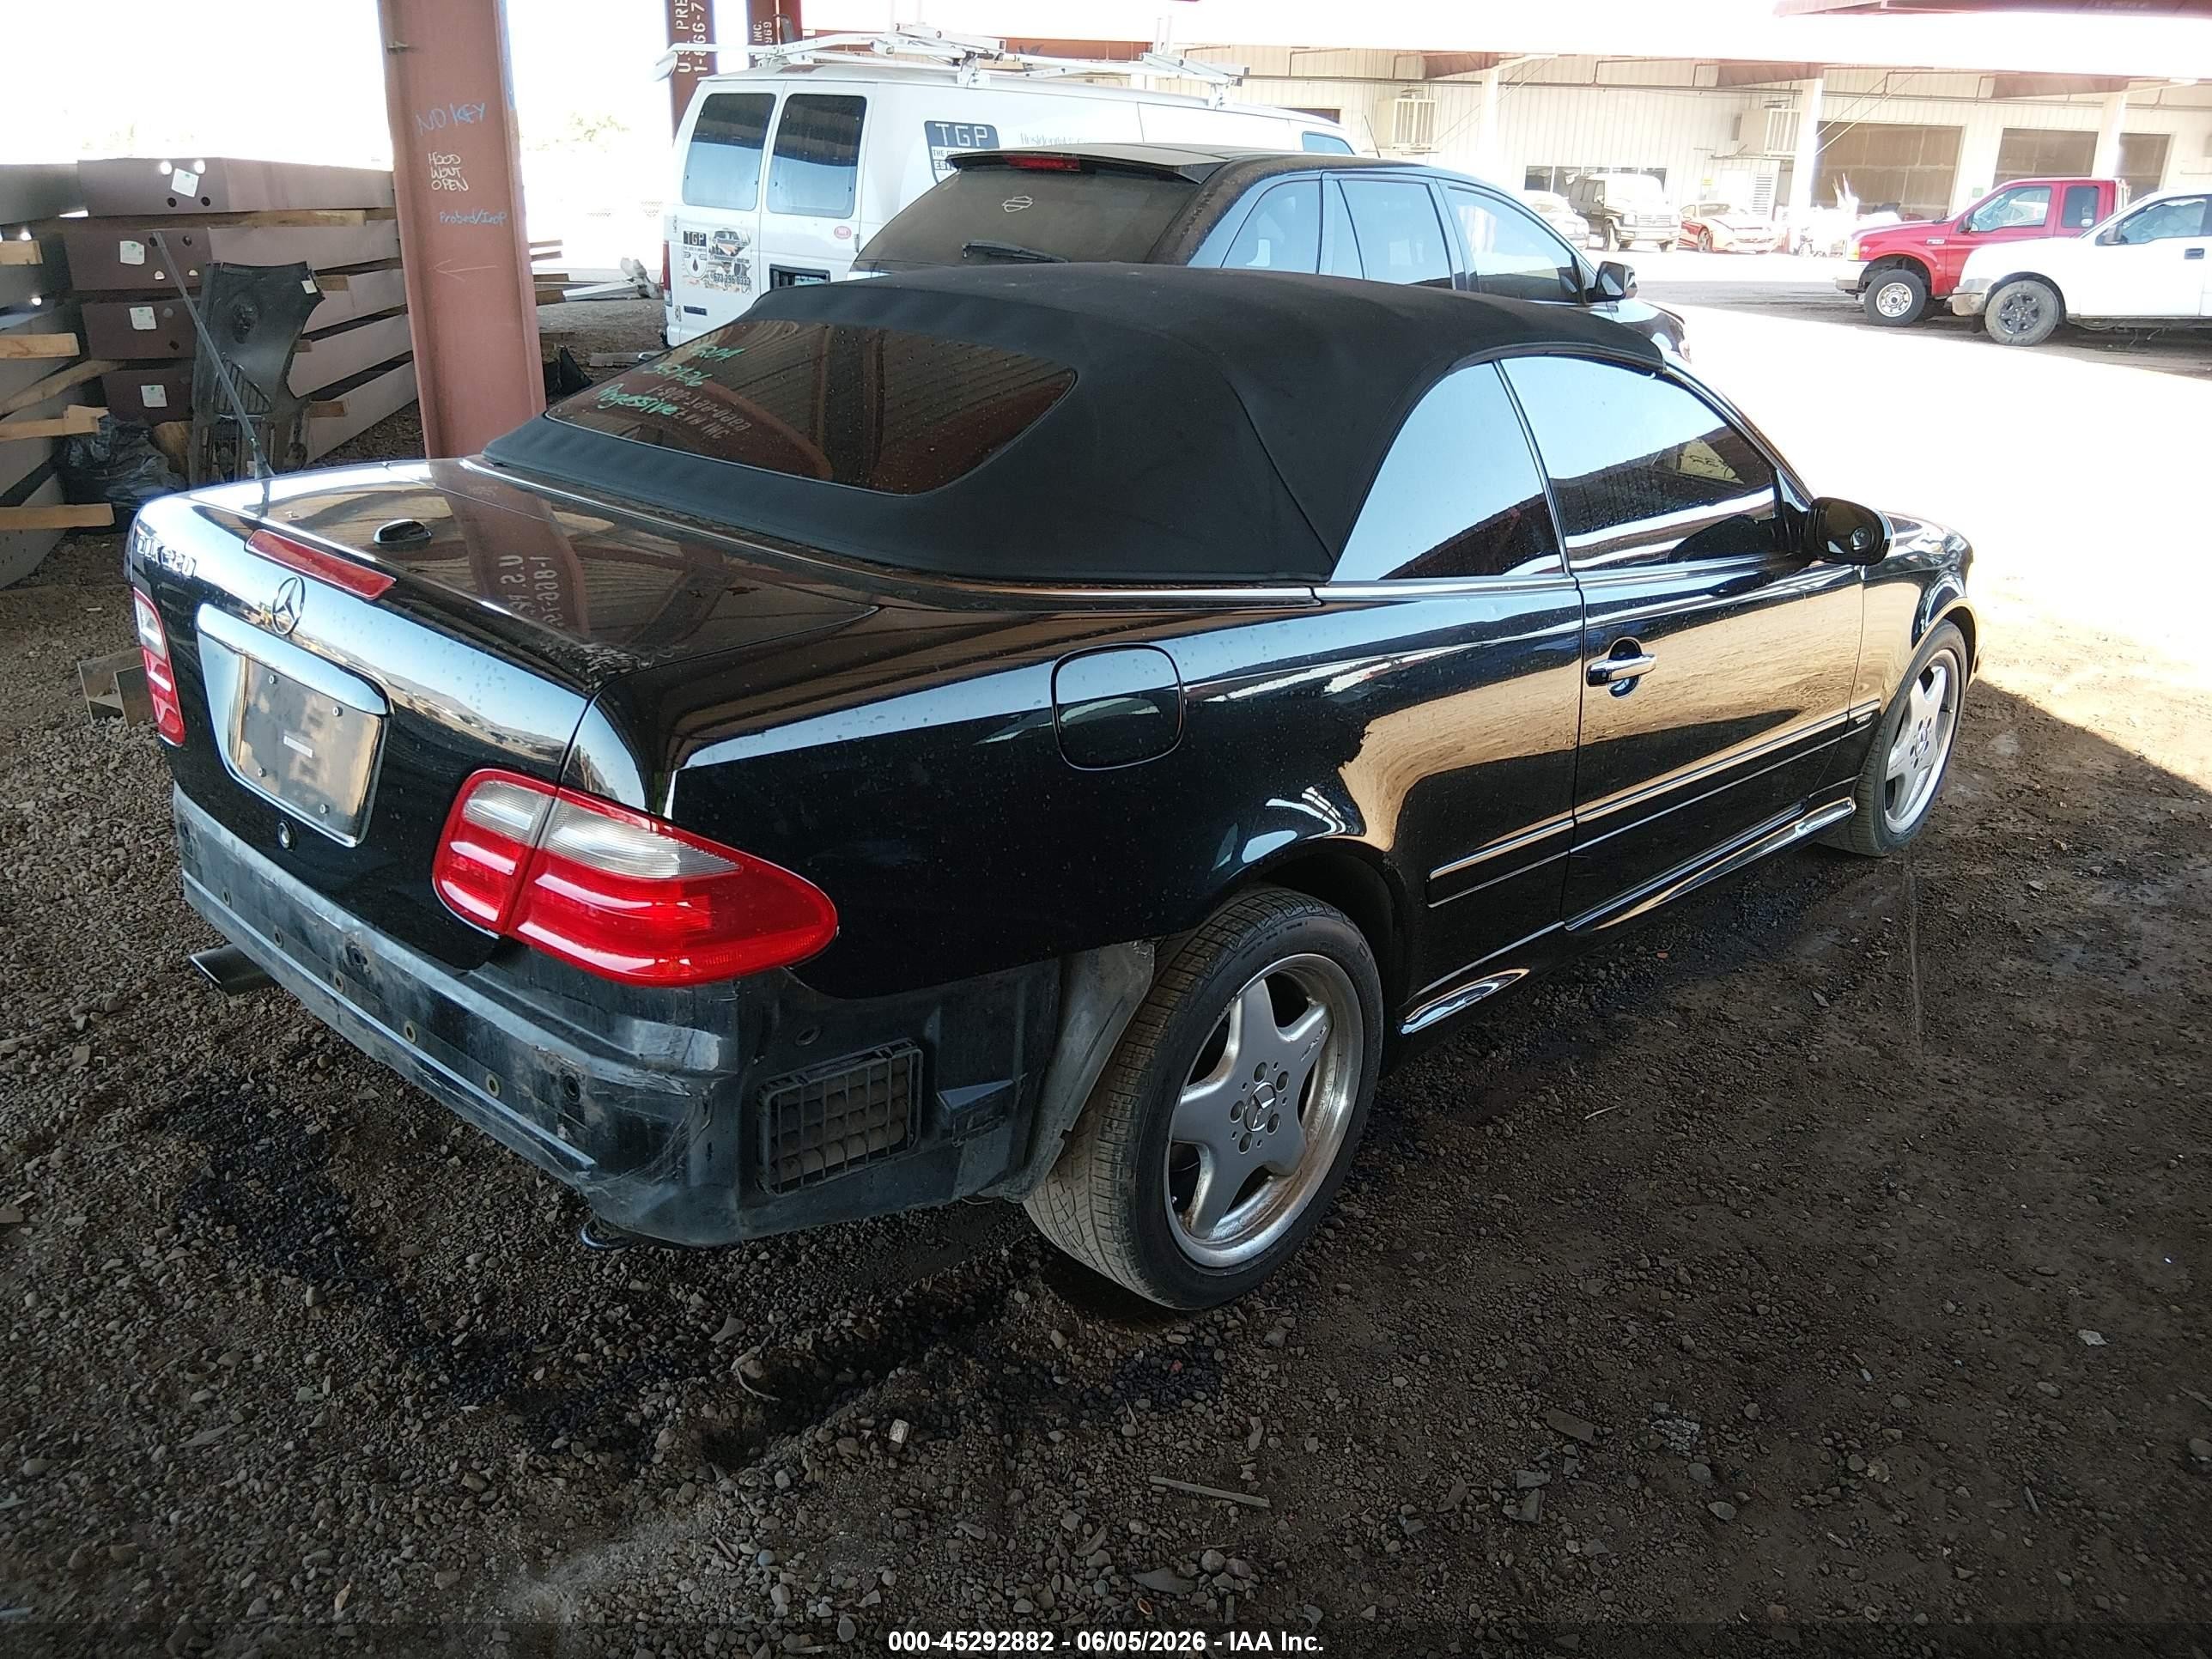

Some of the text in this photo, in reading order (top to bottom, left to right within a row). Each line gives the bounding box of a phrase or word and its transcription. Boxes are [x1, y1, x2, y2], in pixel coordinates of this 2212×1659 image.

[416, 108, 447, 136] NO
[934, 123, 988, 147] TGP
[431, 177, 469, 192] OPEN
[686, 231, 705, 247] TGP
